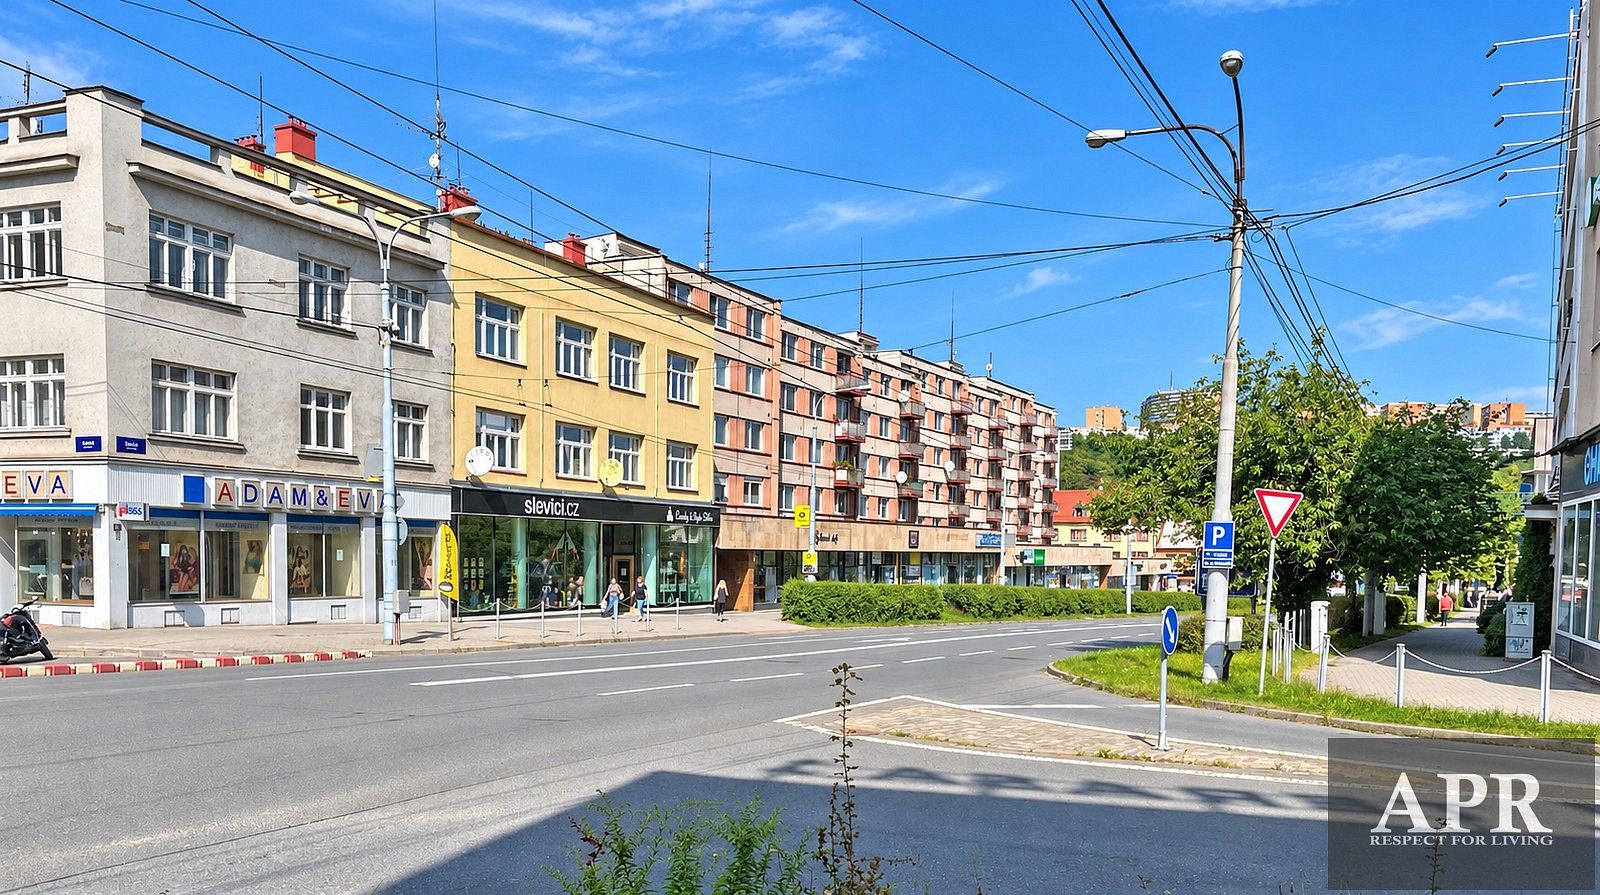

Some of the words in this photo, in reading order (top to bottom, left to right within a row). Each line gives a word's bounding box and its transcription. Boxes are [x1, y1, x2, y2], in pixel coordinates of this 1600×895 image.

[4, 475, 66, 494] EVA
[524, 496, 580, 517] slevici.cz
[1211, 525, 1226, 546] P
